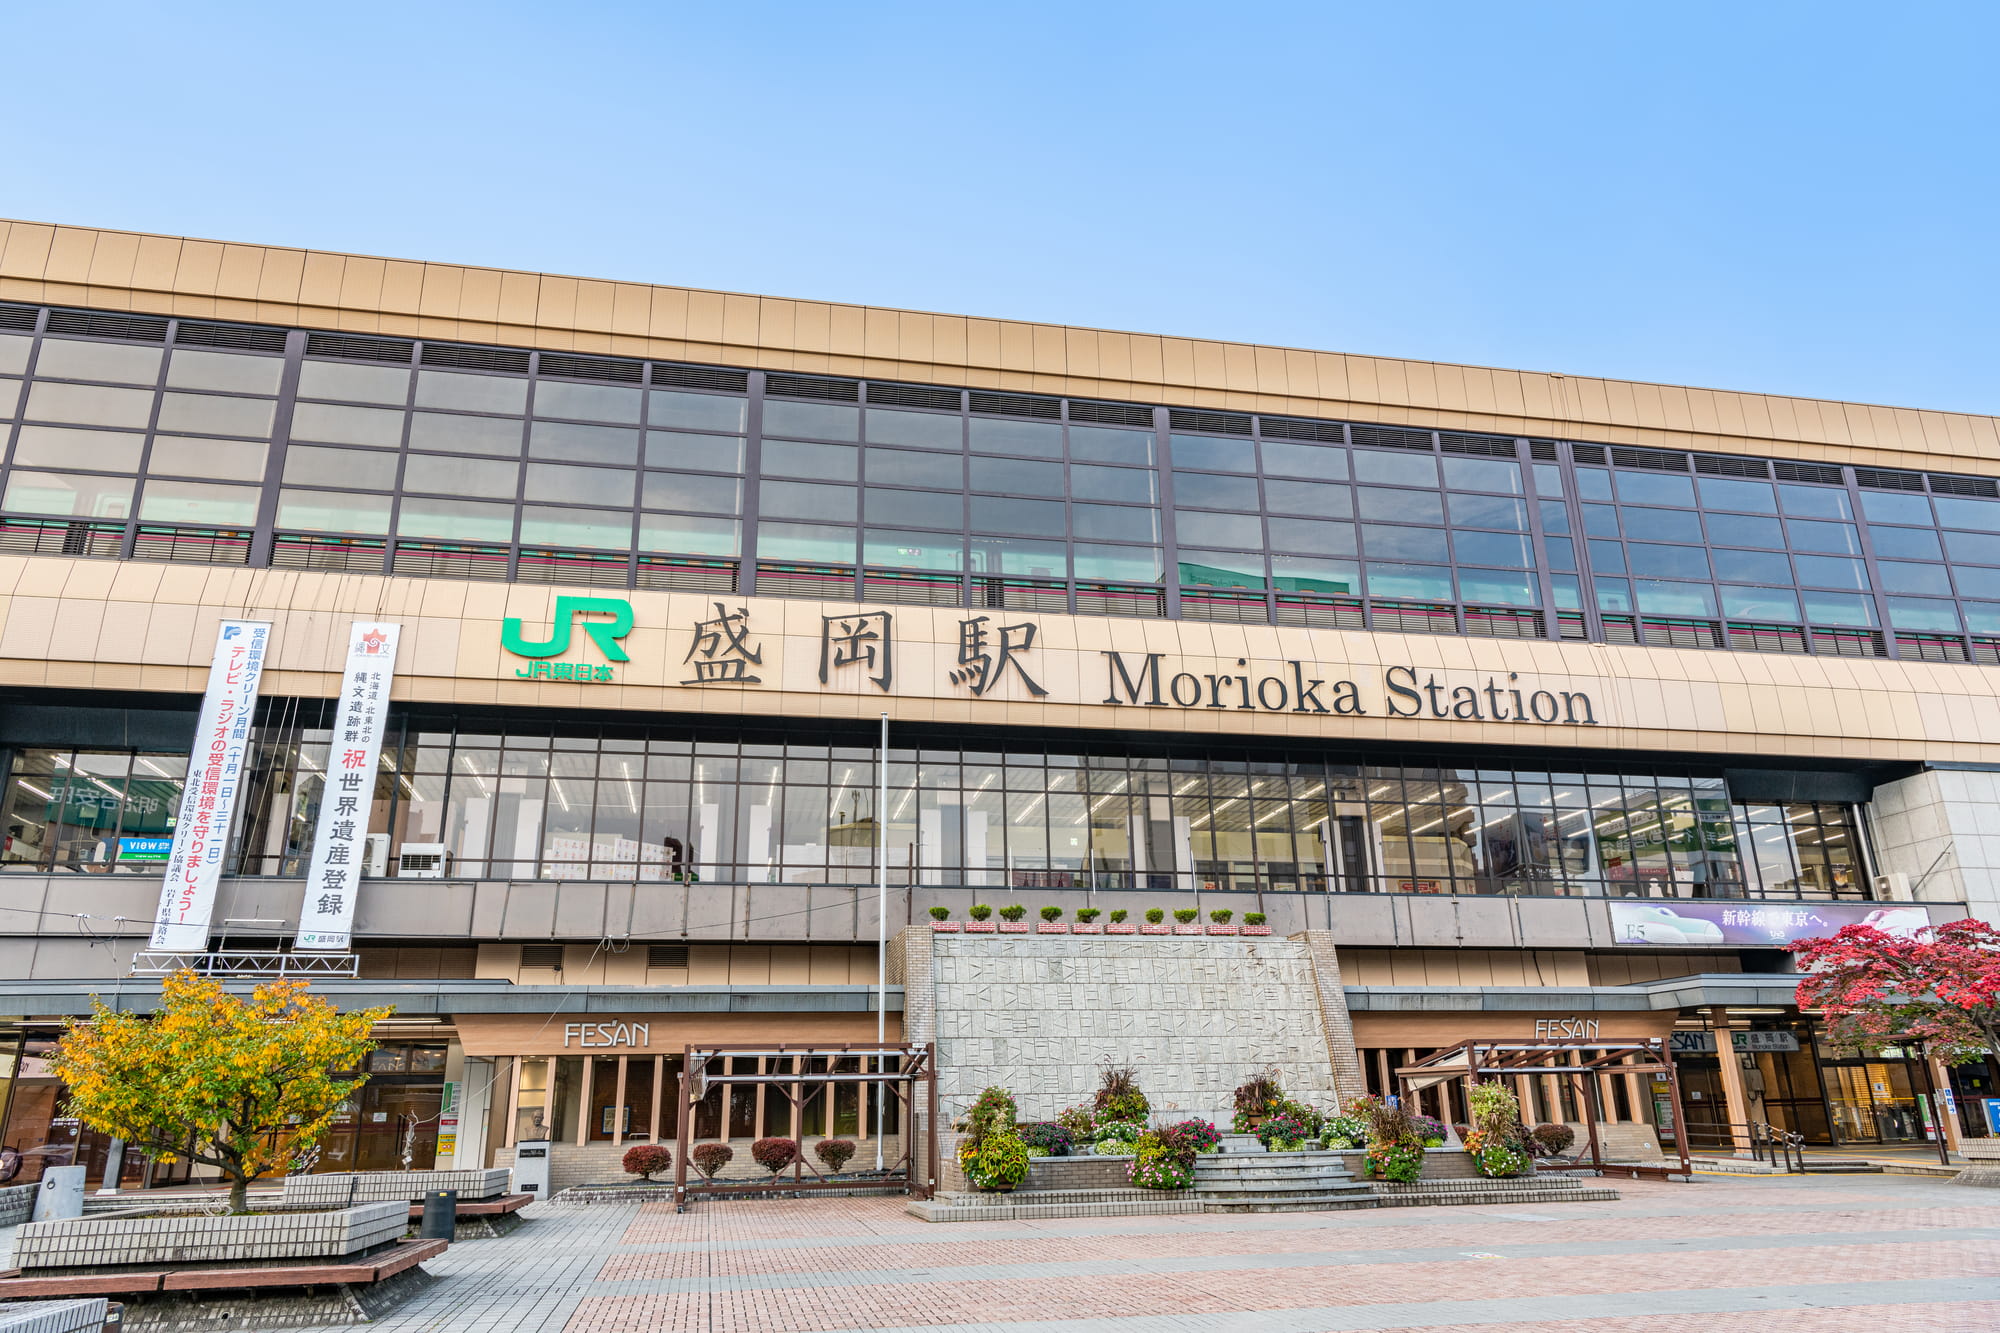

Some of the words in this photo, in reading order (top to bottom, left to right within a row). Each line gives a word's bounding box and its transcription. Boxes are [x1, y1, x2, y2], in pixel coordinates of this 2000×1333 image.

[501, 595, 634, 661] JR
[679, 601, 1049, 697] 盛岡駅
[515, 660, 614, 682] JR東日本
[1100, 650, 1366, 715] Morioka
[1386, 665, 1598, 725] Station
[344, 671, 368, 743] 縄文遺跡群
[361, 671, 381, 743] 北海道・北東北の
[341, 749, 367, 769] 祝
[317, 772, 363, 917] 世界遺産登録
[318, 934, 344, 943] 盛岡駅
[1722, 909, 1829, 928] 新幹線で東京へ。
